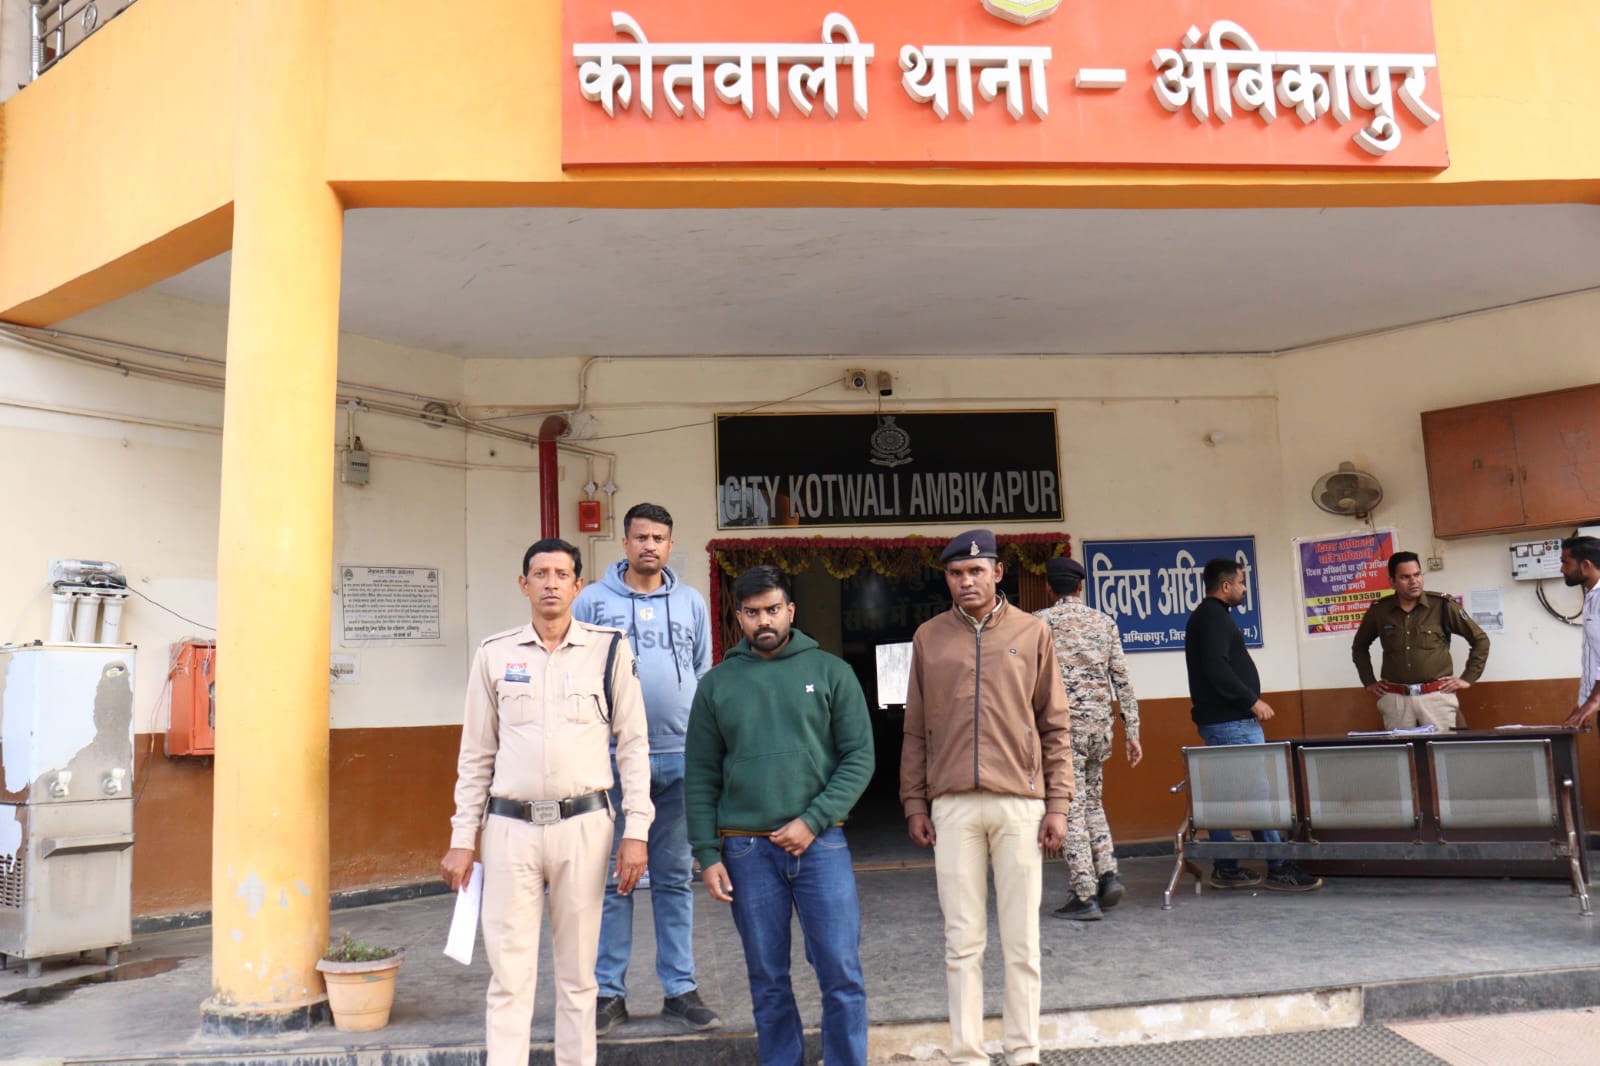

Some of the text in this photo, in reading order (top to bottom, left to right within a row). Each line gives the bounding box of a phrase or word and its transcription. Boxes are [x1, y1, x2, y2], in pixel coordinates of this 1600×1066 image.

[573, 11, 875, 120] कोतवाली
[899, 43, 1052, 121] थाना
[1151, 19, 1440, 156] अंबिकापुर
[723, 470, 1058, 521] CITY KOTWALI AMBIKAPUR
[1092, 552, 1151, 621] दिवस
